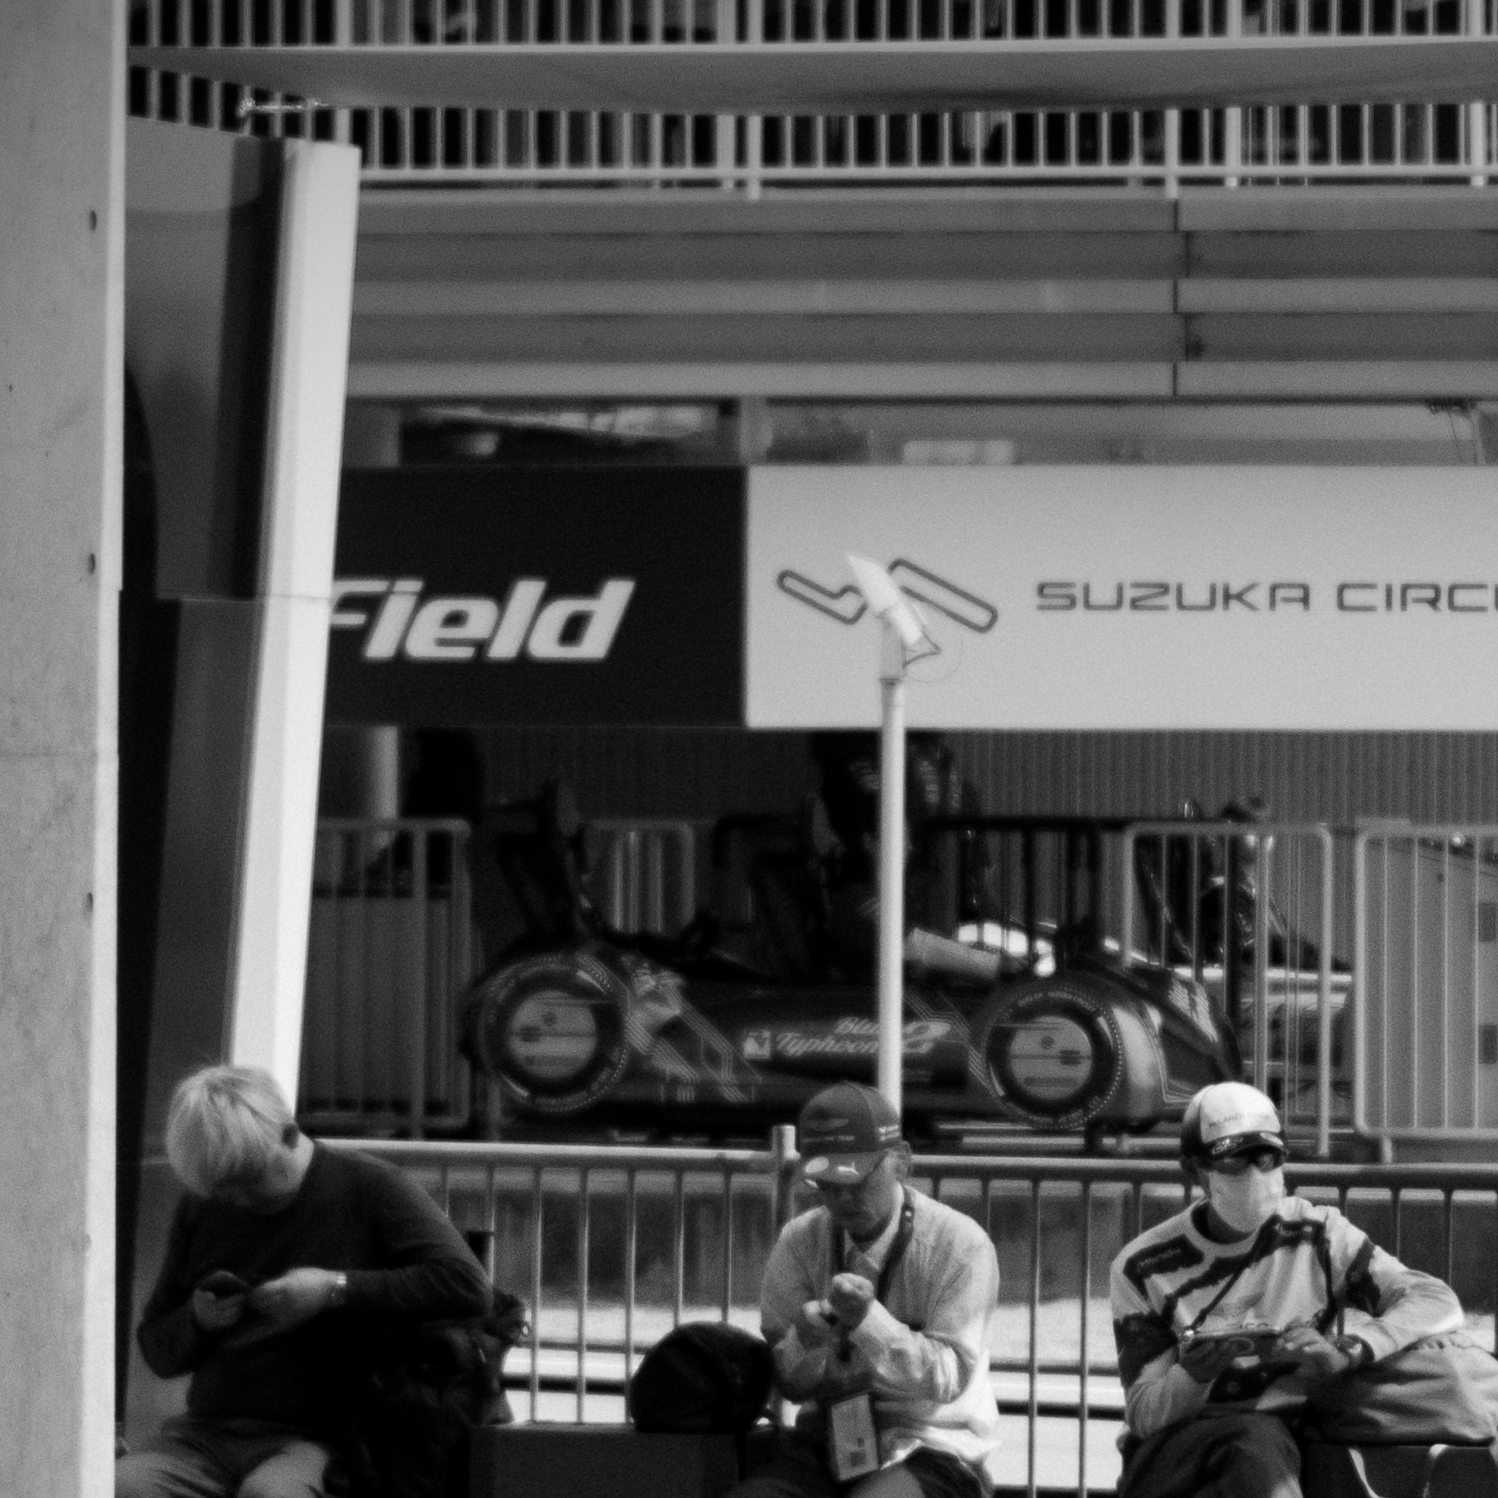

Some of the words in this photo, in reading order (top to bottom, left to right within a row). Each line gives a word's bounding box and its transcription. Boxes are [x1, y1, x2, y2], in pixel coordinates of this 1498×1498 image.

[1034, 580, 1312, 612] SUZUKA
[331, 578, 637, 662] Field
[834, 1017, 879, 1034] Blu
